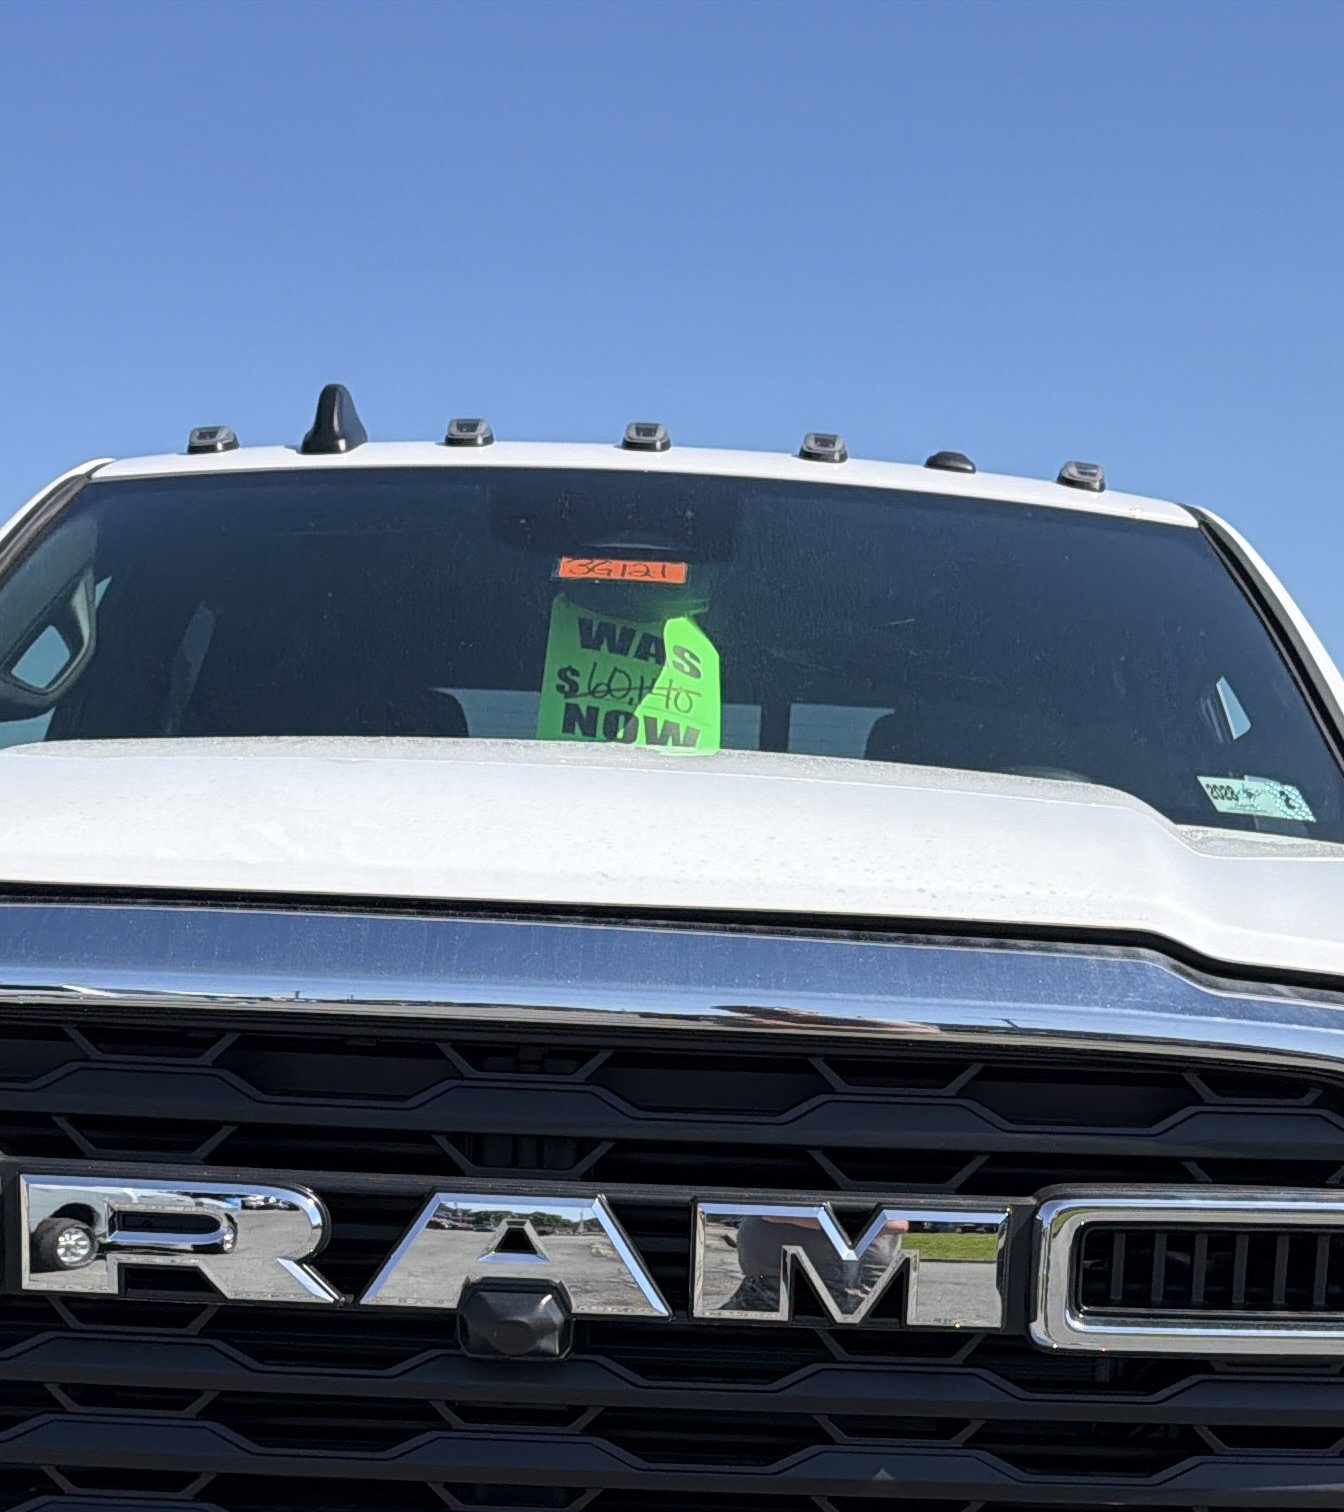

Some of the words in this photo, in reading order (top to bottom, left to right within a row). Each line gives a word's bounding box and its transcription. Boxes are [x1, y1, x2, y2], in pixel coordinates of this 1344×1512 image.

[577, 616, 702, 680] WAS
[561, 702, 702, 748] NOW
[19, 1173, 1012, 1330] RAM
